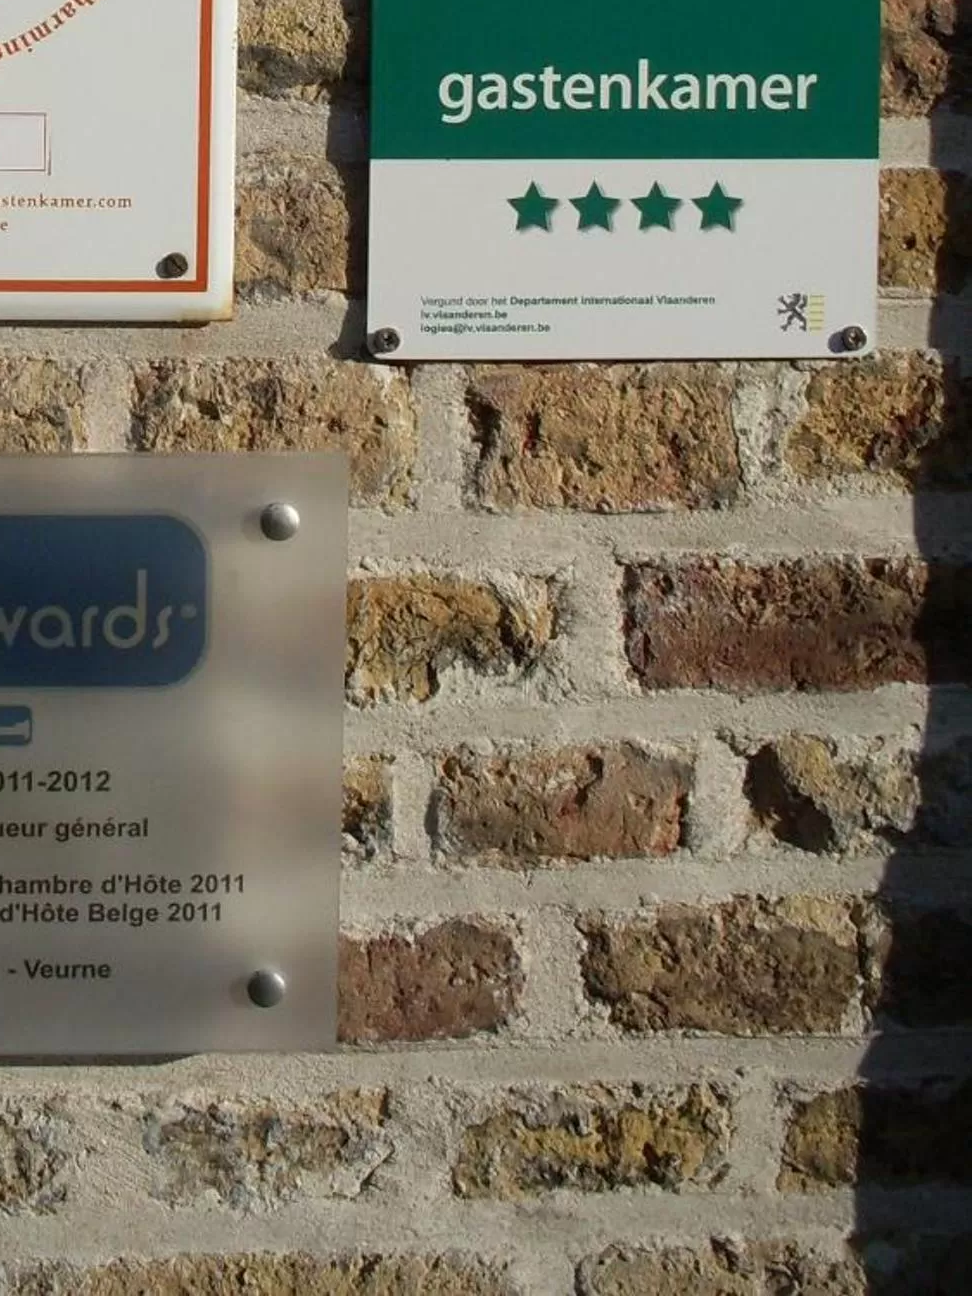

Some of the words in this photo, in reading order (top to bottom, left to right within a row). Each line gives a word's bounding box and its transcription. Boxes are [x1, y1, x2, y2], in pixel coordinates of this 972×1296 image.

[438, 59, 818, 124] gastenkamer
[655, 294, 716, 306] Vlaanderen
[55, 817, 149, 842] général
[101, 874, 182, 895] d'Hôte
[190, 874, 245, 894] 2011
[88, 902, 160, 927] Belge
[167, 901, 223, 922] 2011
[23, 958, 112, 980] Veurne
